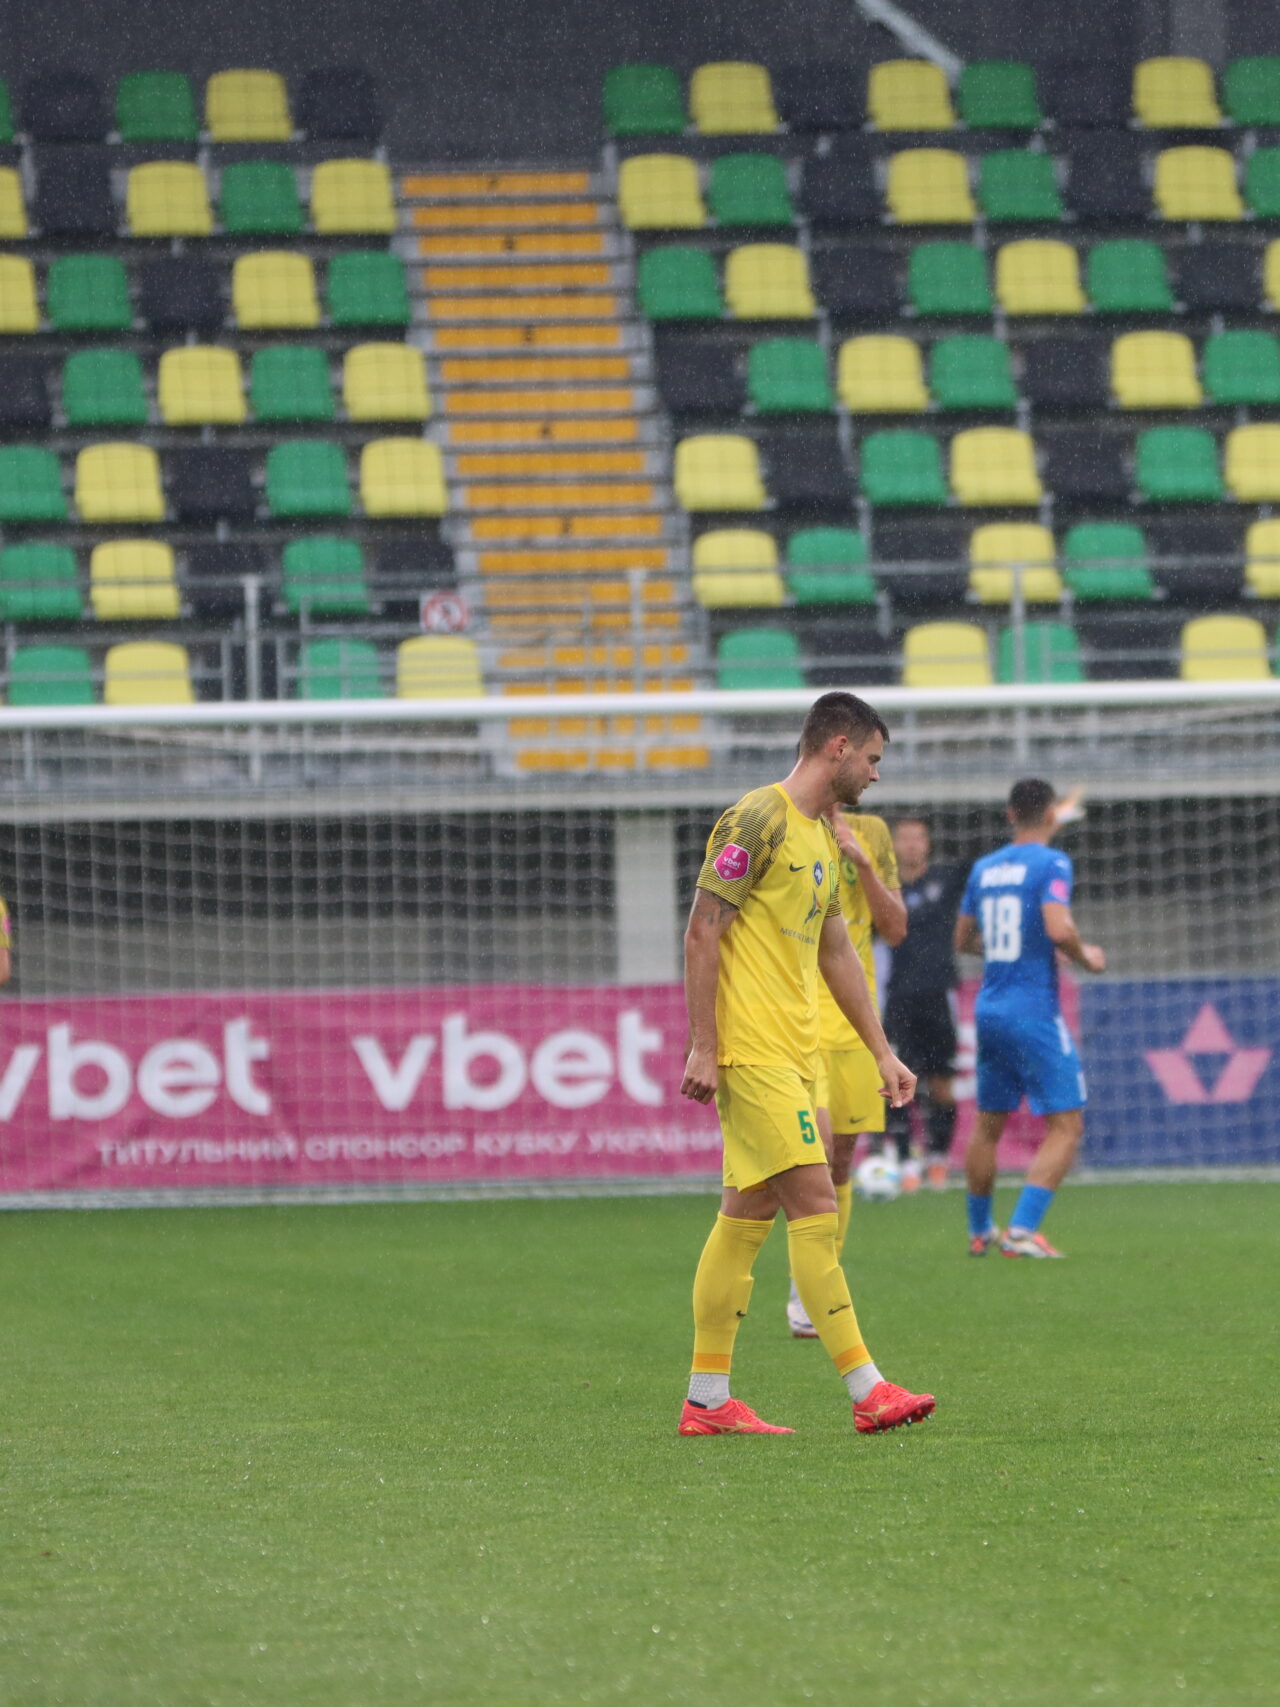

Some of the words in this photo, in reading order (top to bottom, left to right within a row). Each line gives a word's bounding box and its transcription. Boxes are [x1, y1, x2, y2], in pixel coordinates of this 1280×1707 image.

[981, 894, 1022, 963] 18
[352, 1010, 664, 1112] vbet
[100, 1132, 297, 1165] ТИТУЛЬНИЙ
[305, 1130, 465, 1162] СПОНСОР
[473, 1129, 579, 1156] КУБКУ
[797, 1110, 816, 1145] 5
